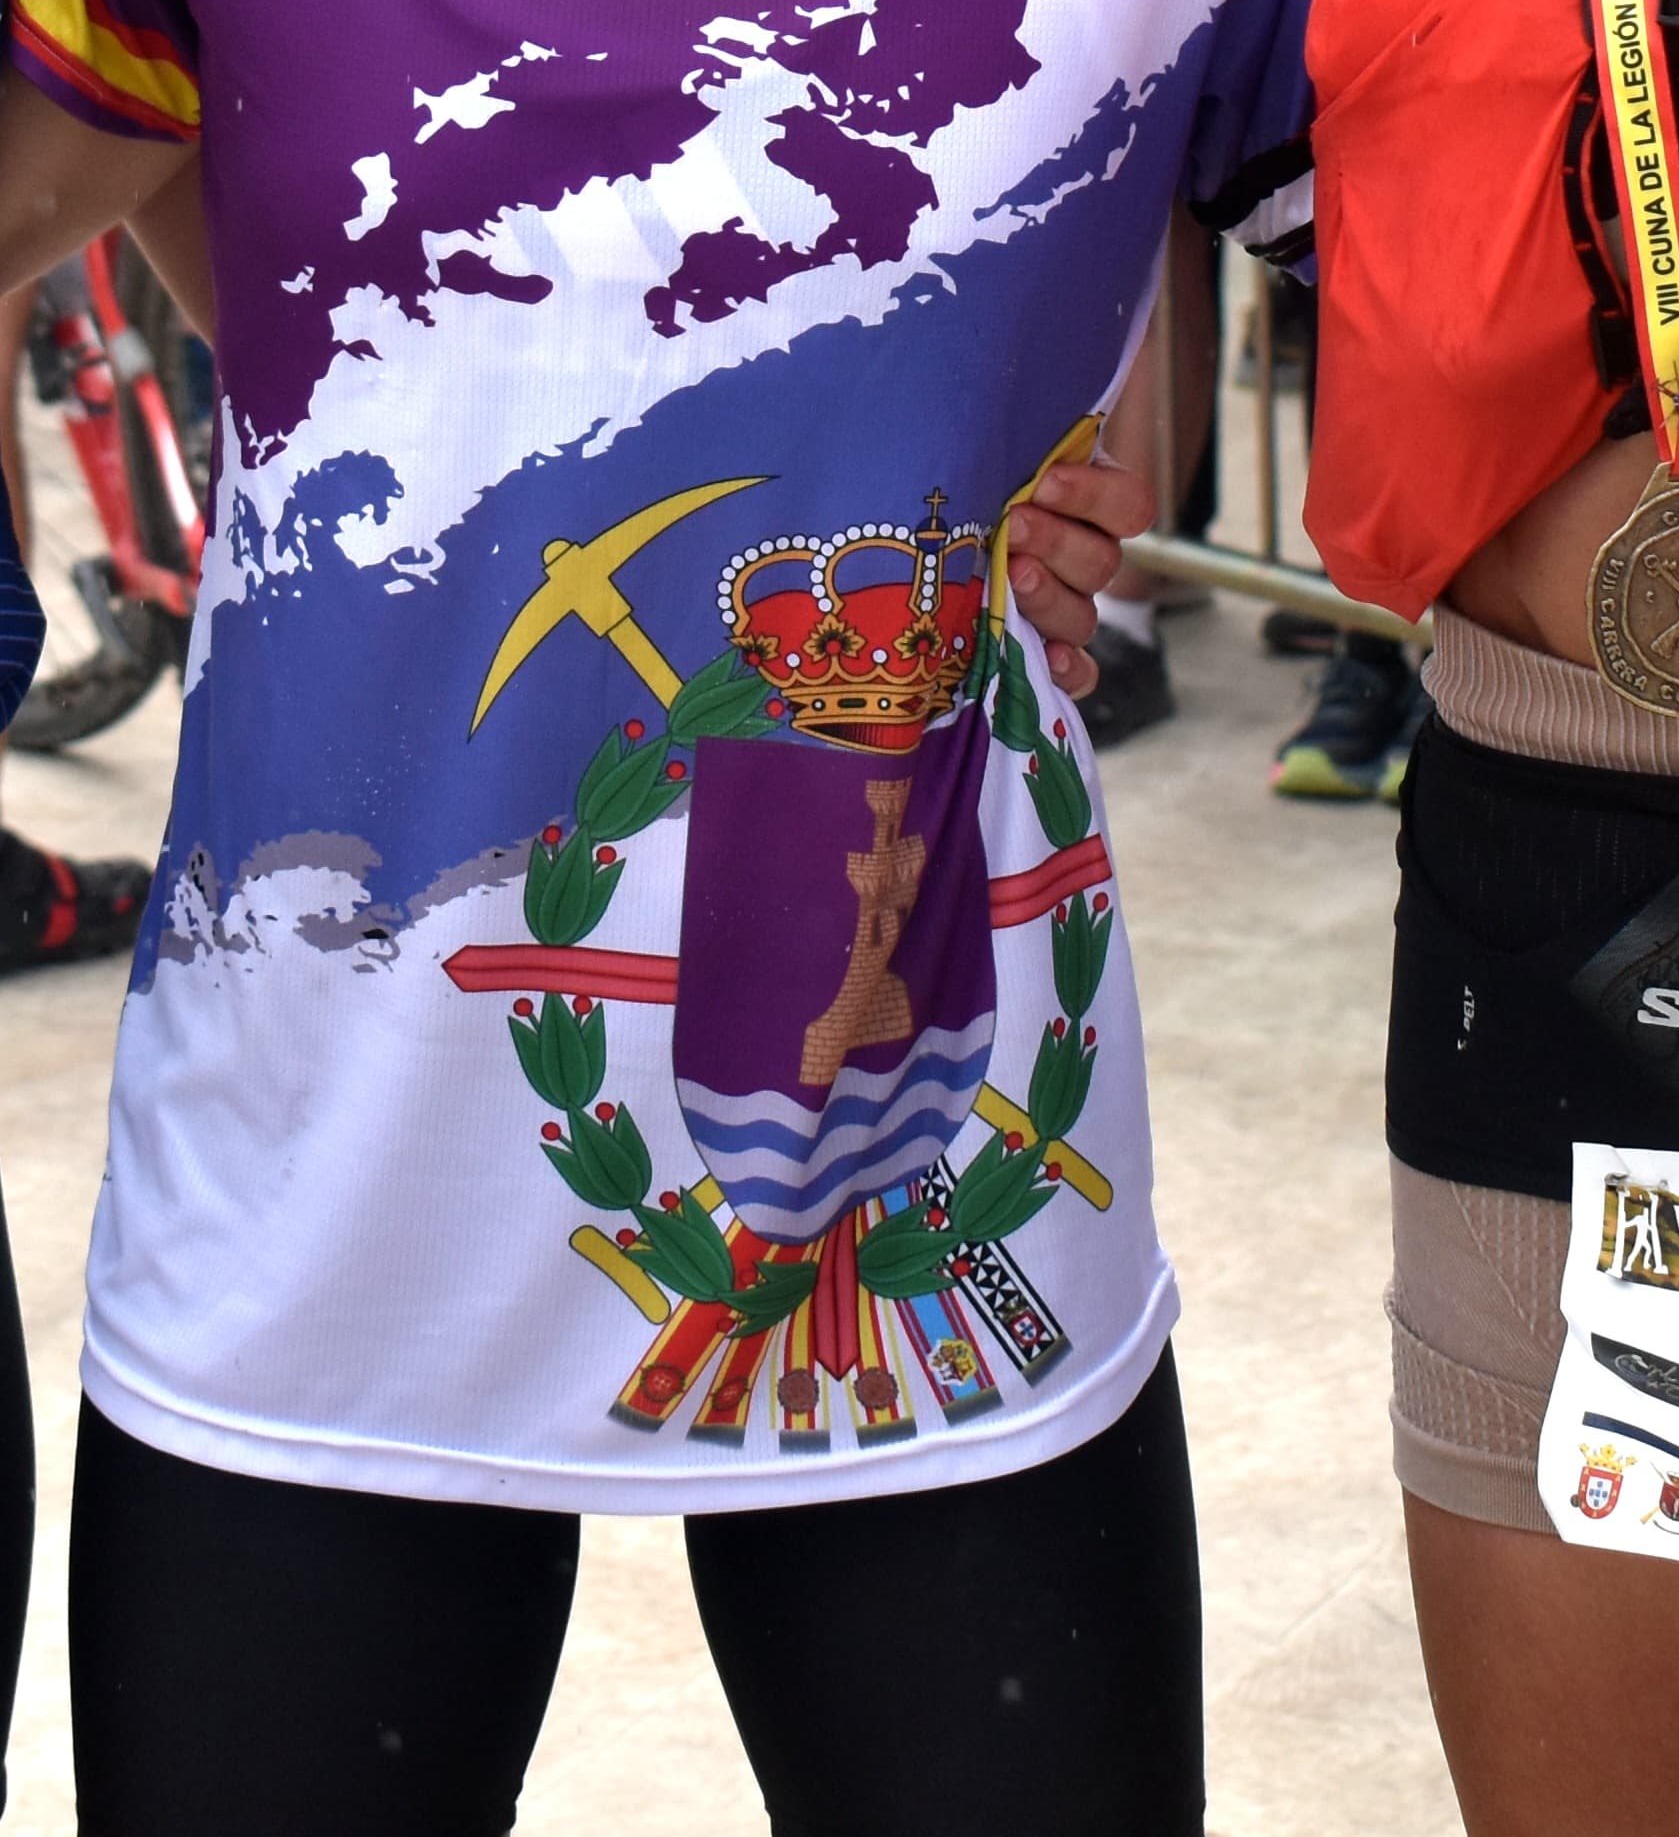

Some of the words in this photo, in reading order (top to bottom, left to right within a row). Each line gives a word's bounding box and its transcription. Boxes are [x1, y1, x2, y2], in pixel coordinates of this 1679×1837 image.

[1612, 2, 1650, 105] LEGIÓN
[1630, 108, 1658, 147] LA
[1636, 152, 1664, 193] DE
[1643, 195, 1677, 277] CUNA
[1600, 557, 1625, 592] VIII
[1598, 596, 1650, 693] CARRERA
